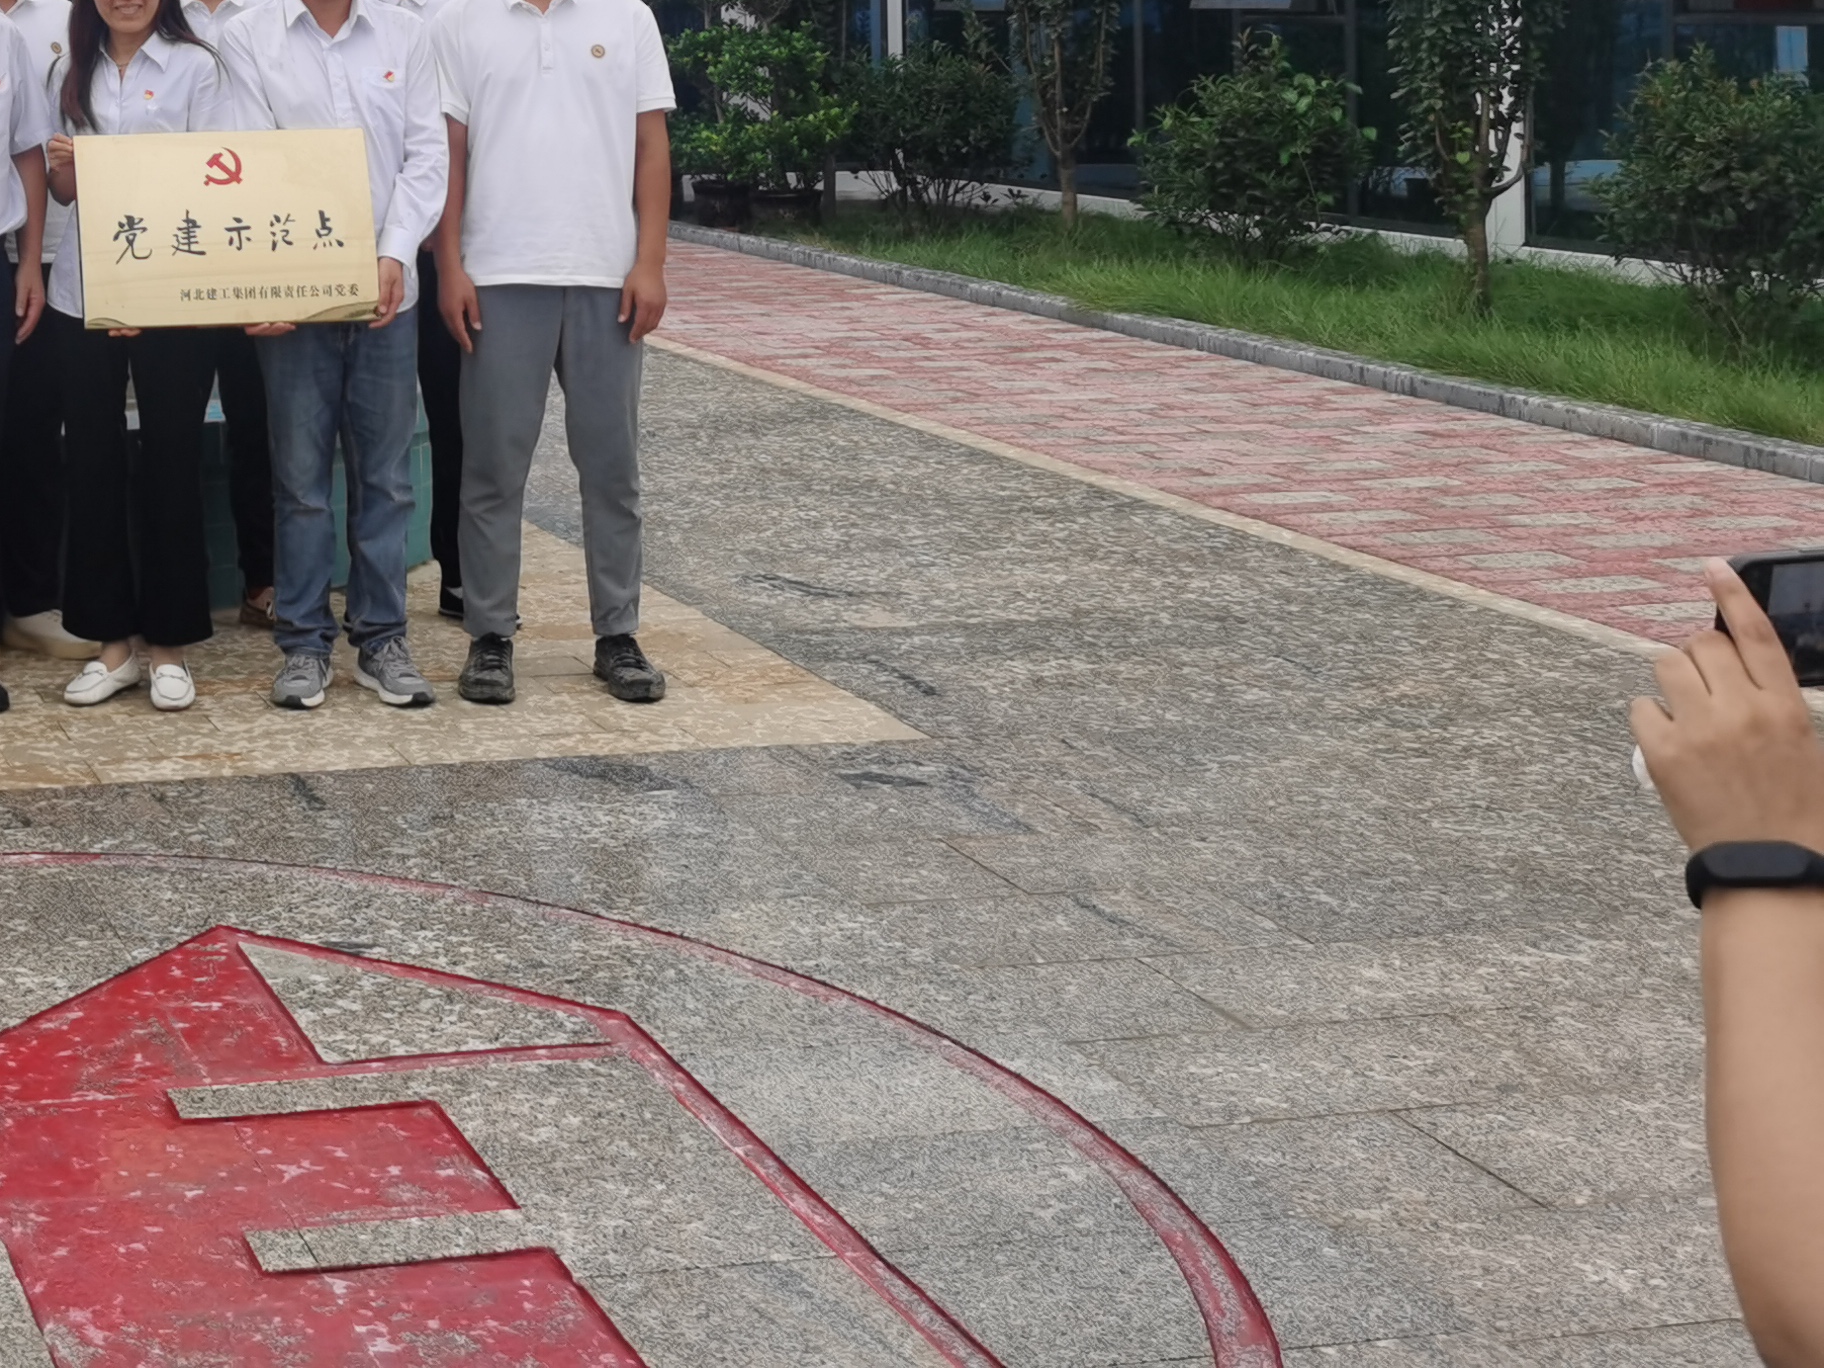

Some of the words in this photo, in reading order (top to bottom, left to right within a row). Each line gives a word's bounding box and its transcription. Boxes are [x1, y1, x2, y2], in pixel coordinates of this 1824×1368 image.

[113, 210, 344, 264] 党建示范点
[180, 283, 360, 302] 河北建工集团有限责任公司党委
